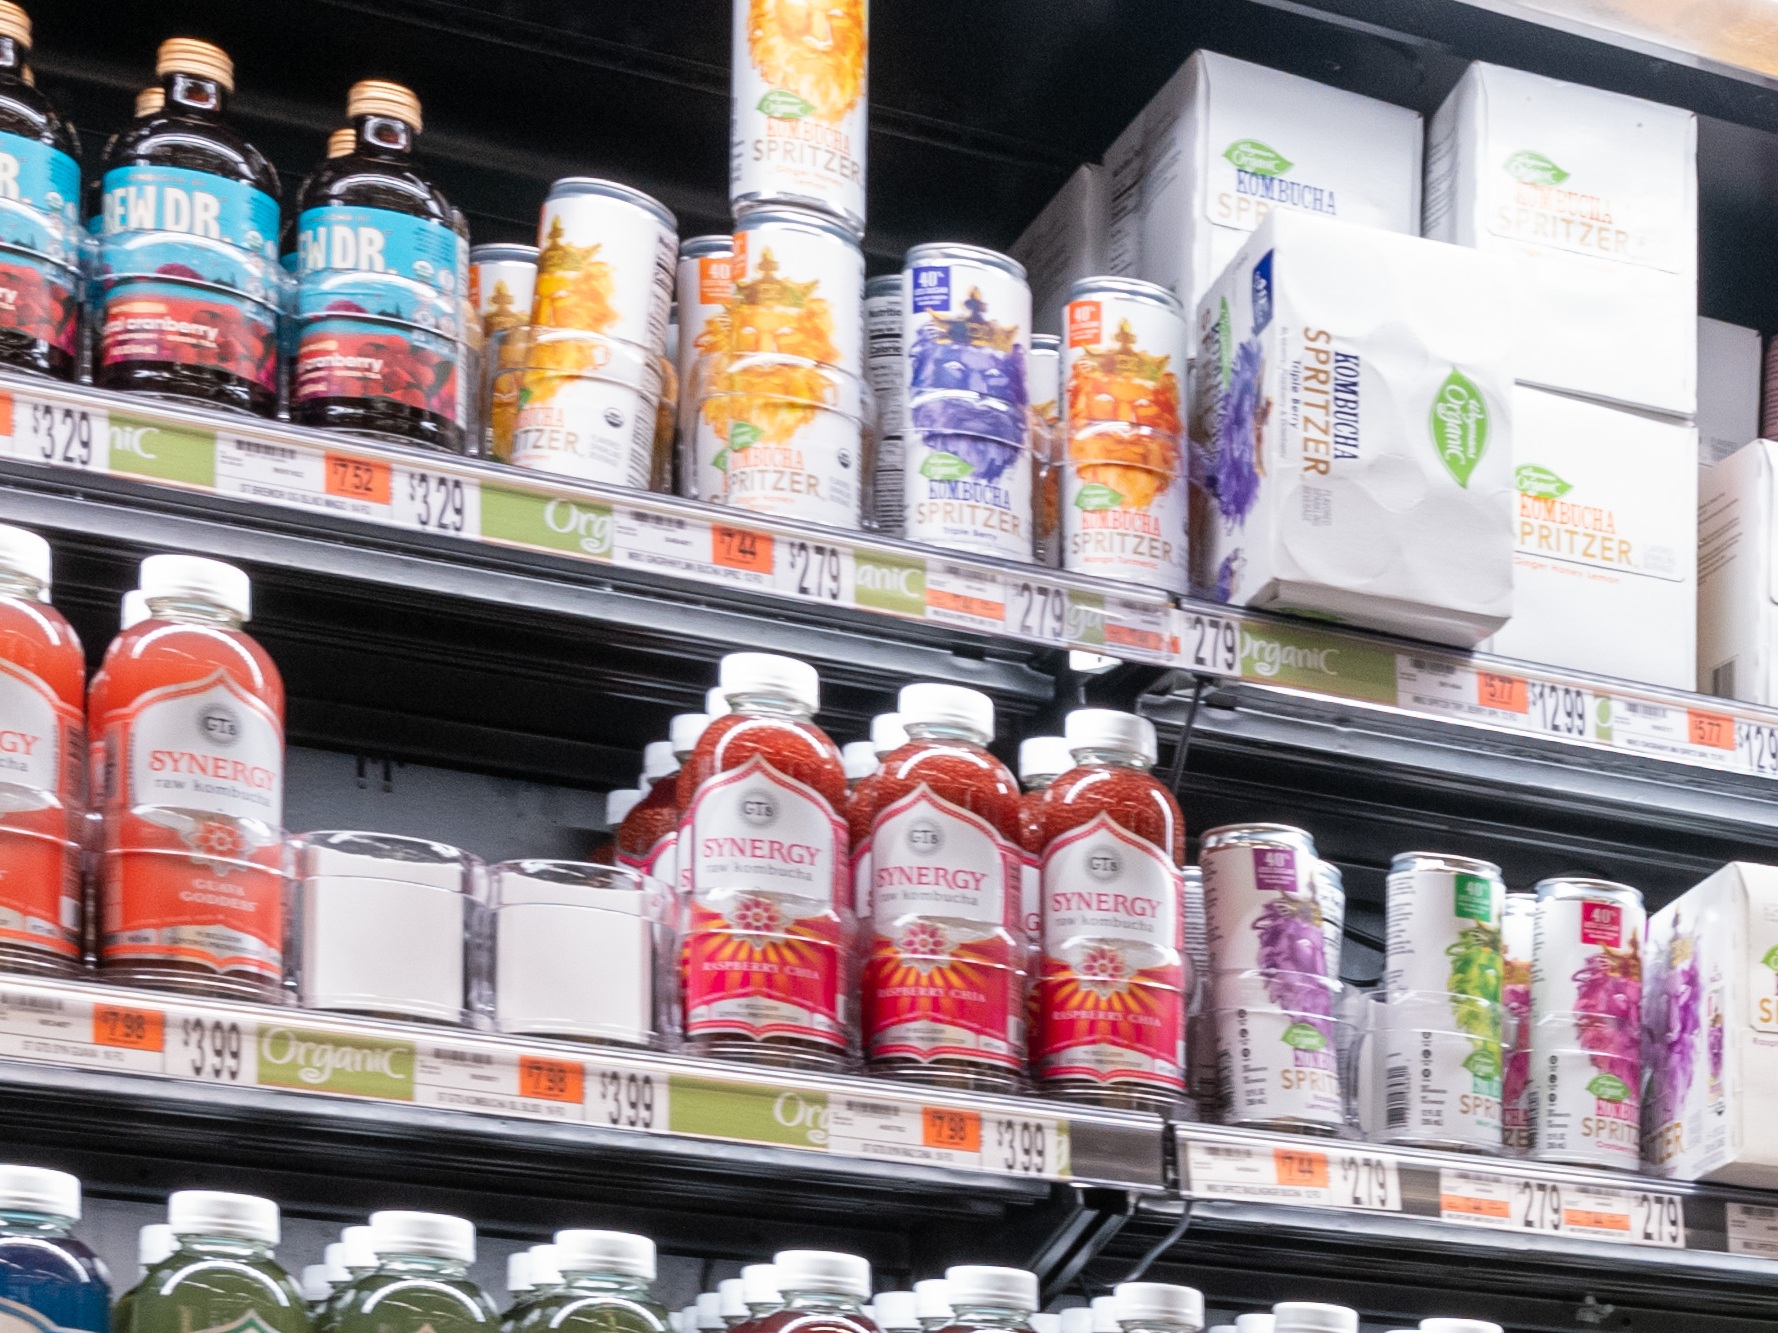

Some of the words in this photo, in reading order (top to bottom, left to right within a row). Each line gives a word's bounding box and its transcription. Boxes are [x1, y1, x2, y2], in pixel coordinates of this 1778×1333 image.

[752, 138, 863, 182] SPRITZER
[1235, 168, 1337, 217] KOMBUCHA
[1515, 181, 1614, 226] KOMBUCHA
[1498, 206, 1631, 255] SPRITZER
[1303, 325, 1332, 477] SPRITZER
[1334, 351, 1361, 462] KOMBUCHA
[927, 480, 1012, 512] KOMBUCHA
[1517, 495, 1616, 536] KOMBUCHA
[915, 500, 1022, 538] SPRITZER
[1080, 509, 1162, 538] KOMBUCHA
[1071, 532, 1174, 564] SPRITZER
[149, 750, 275, 791] SYNERGY
[703, 837, 822, 866] SYNERGY
[742, 860, 814, 882] kombucha
[876, 865, 988, 892] SYNERGY
[1051, 890, 1161, 919] SYNERGY
[703, 961, 778, 977] RASPBERRY
[786, 965, 820, 980] CHIA
[262, 1028, 405, 1096] Organic
